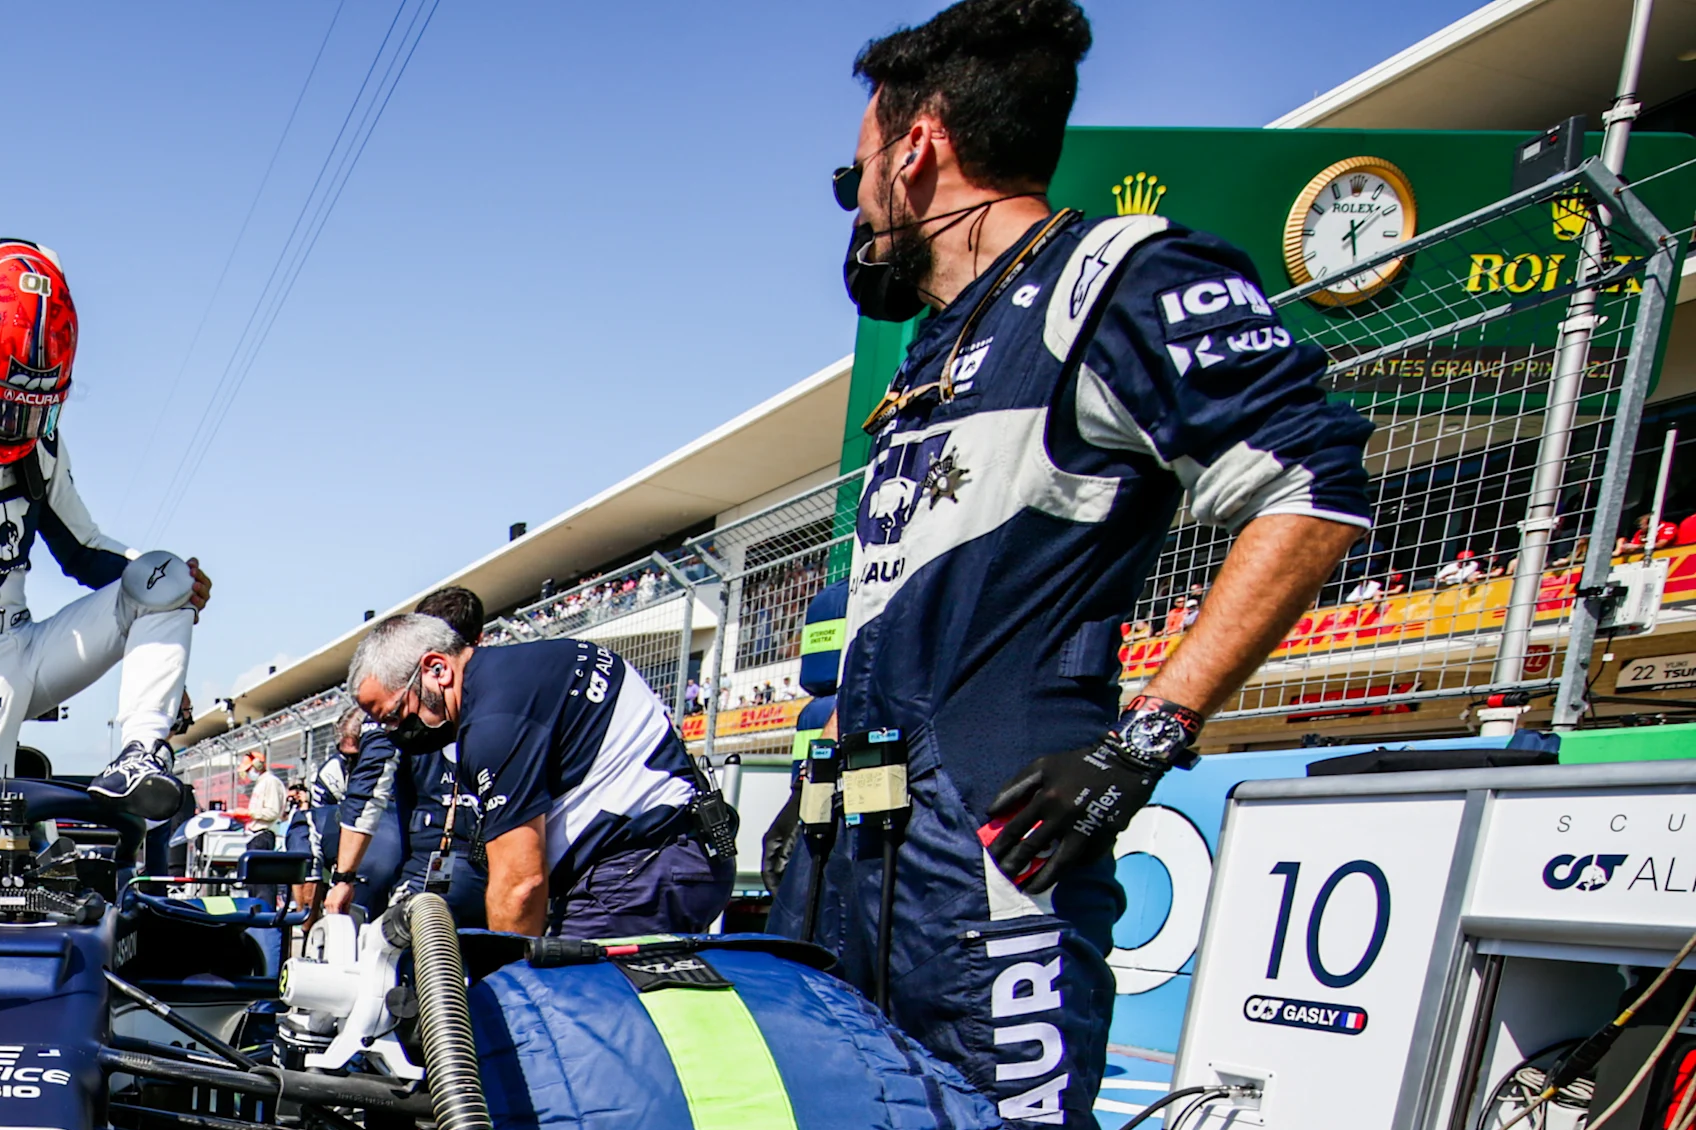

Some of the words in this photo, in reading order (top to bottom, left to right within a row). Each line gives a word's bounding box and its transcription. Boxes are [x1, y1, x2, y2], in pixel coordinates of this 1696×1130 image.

[1332, 202, 1375, 214] ROLEX
[15, 393, 61, 406] ACURA
[1631, 665, 1656, 682] 22
[1073, 784, 1122, 837] HyFlex
[1266, 859, 1392, 989] 10
[1283, 1004, 1341, 1027] GASLY
